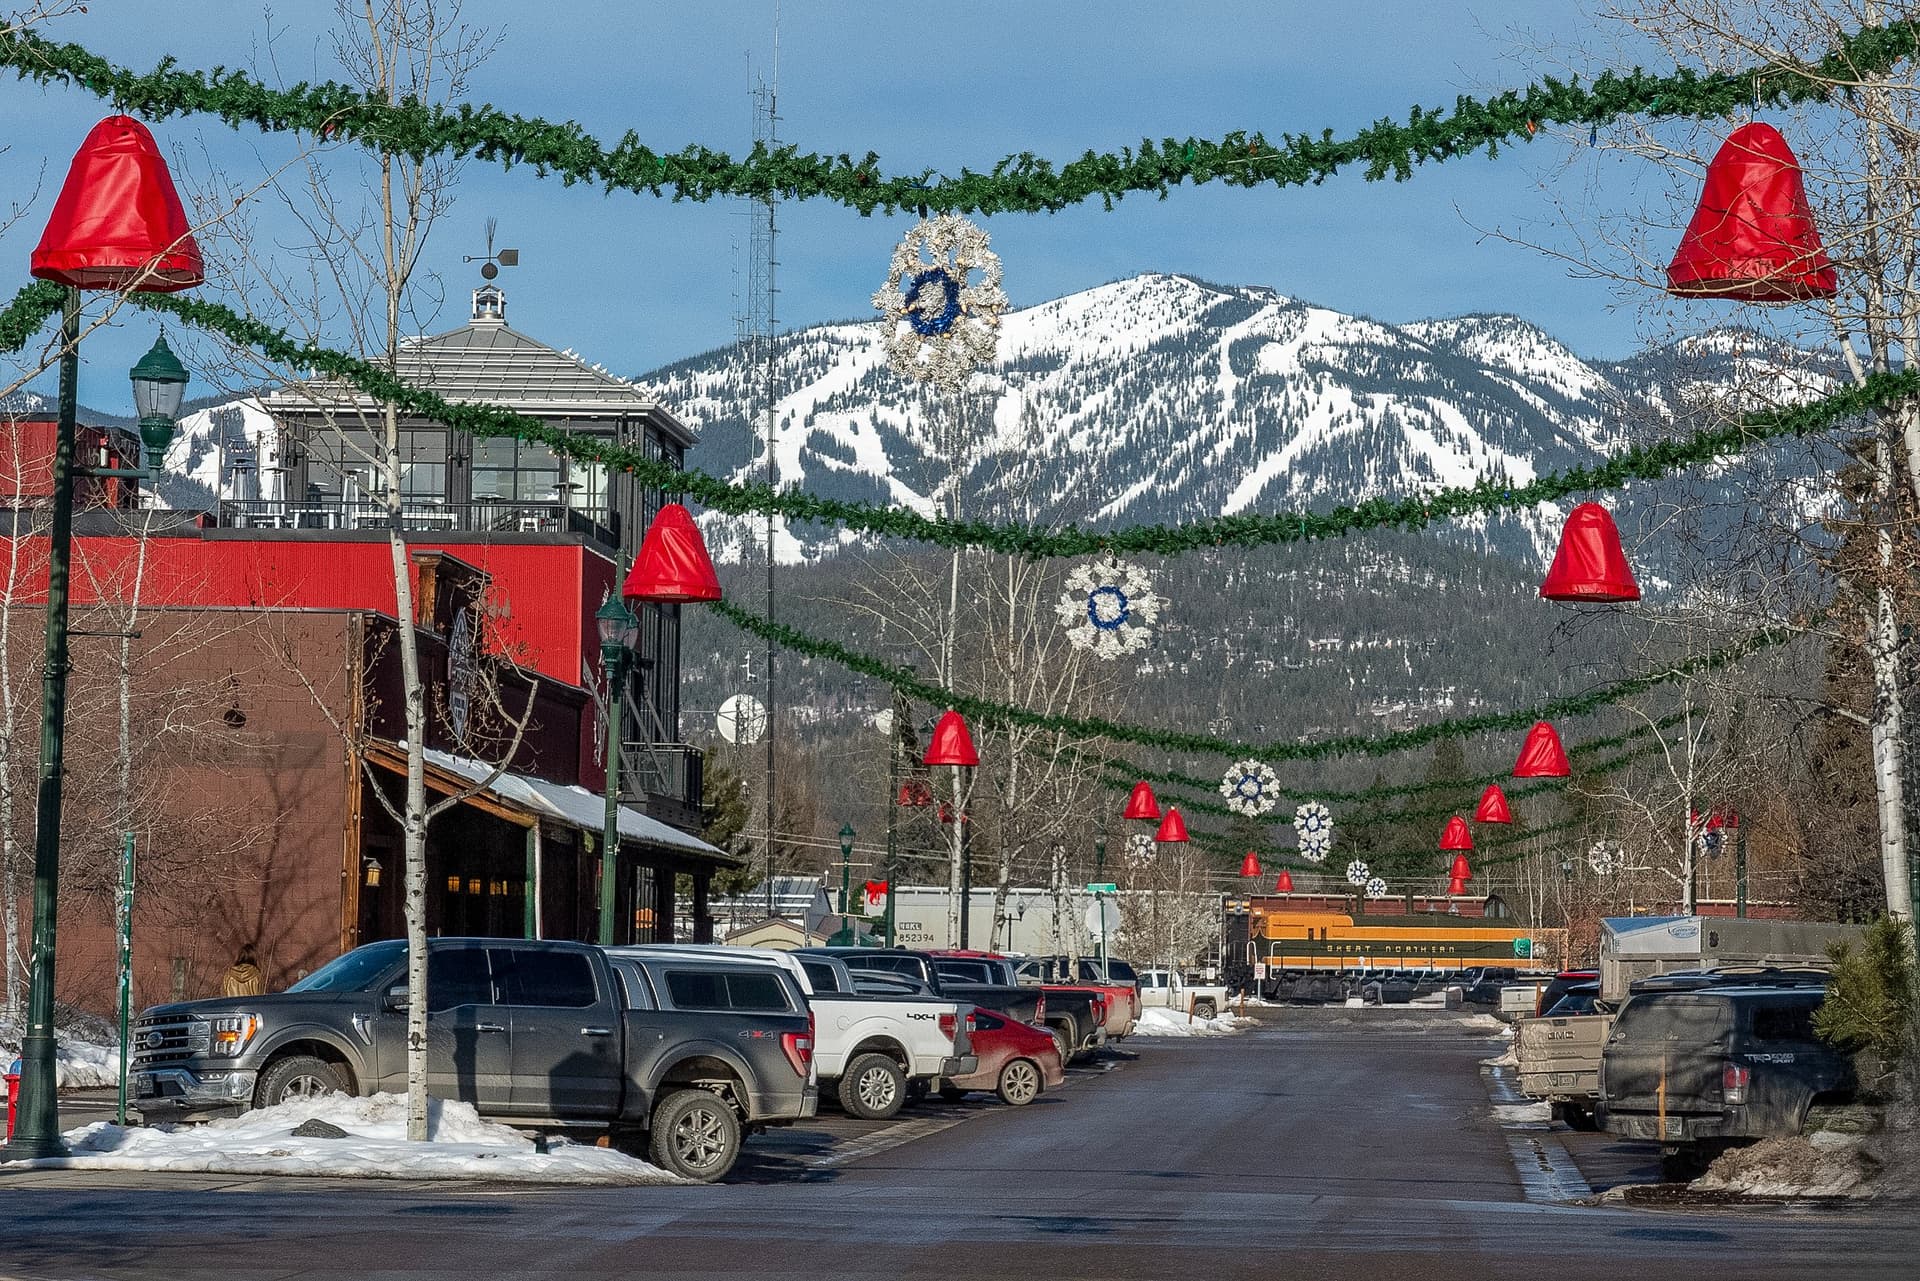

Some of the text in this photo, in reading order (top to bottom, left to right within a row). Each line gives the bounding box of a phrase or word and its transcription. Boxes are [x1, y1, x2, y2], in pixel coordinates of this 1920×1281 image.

[899, 934, 934, 942] 852394
[1385, 945, 1455, 953] NORTHERN
[1547, 1031, 1576, 1040] GMC
[1743, 1053, 1771, 1064] TRD
